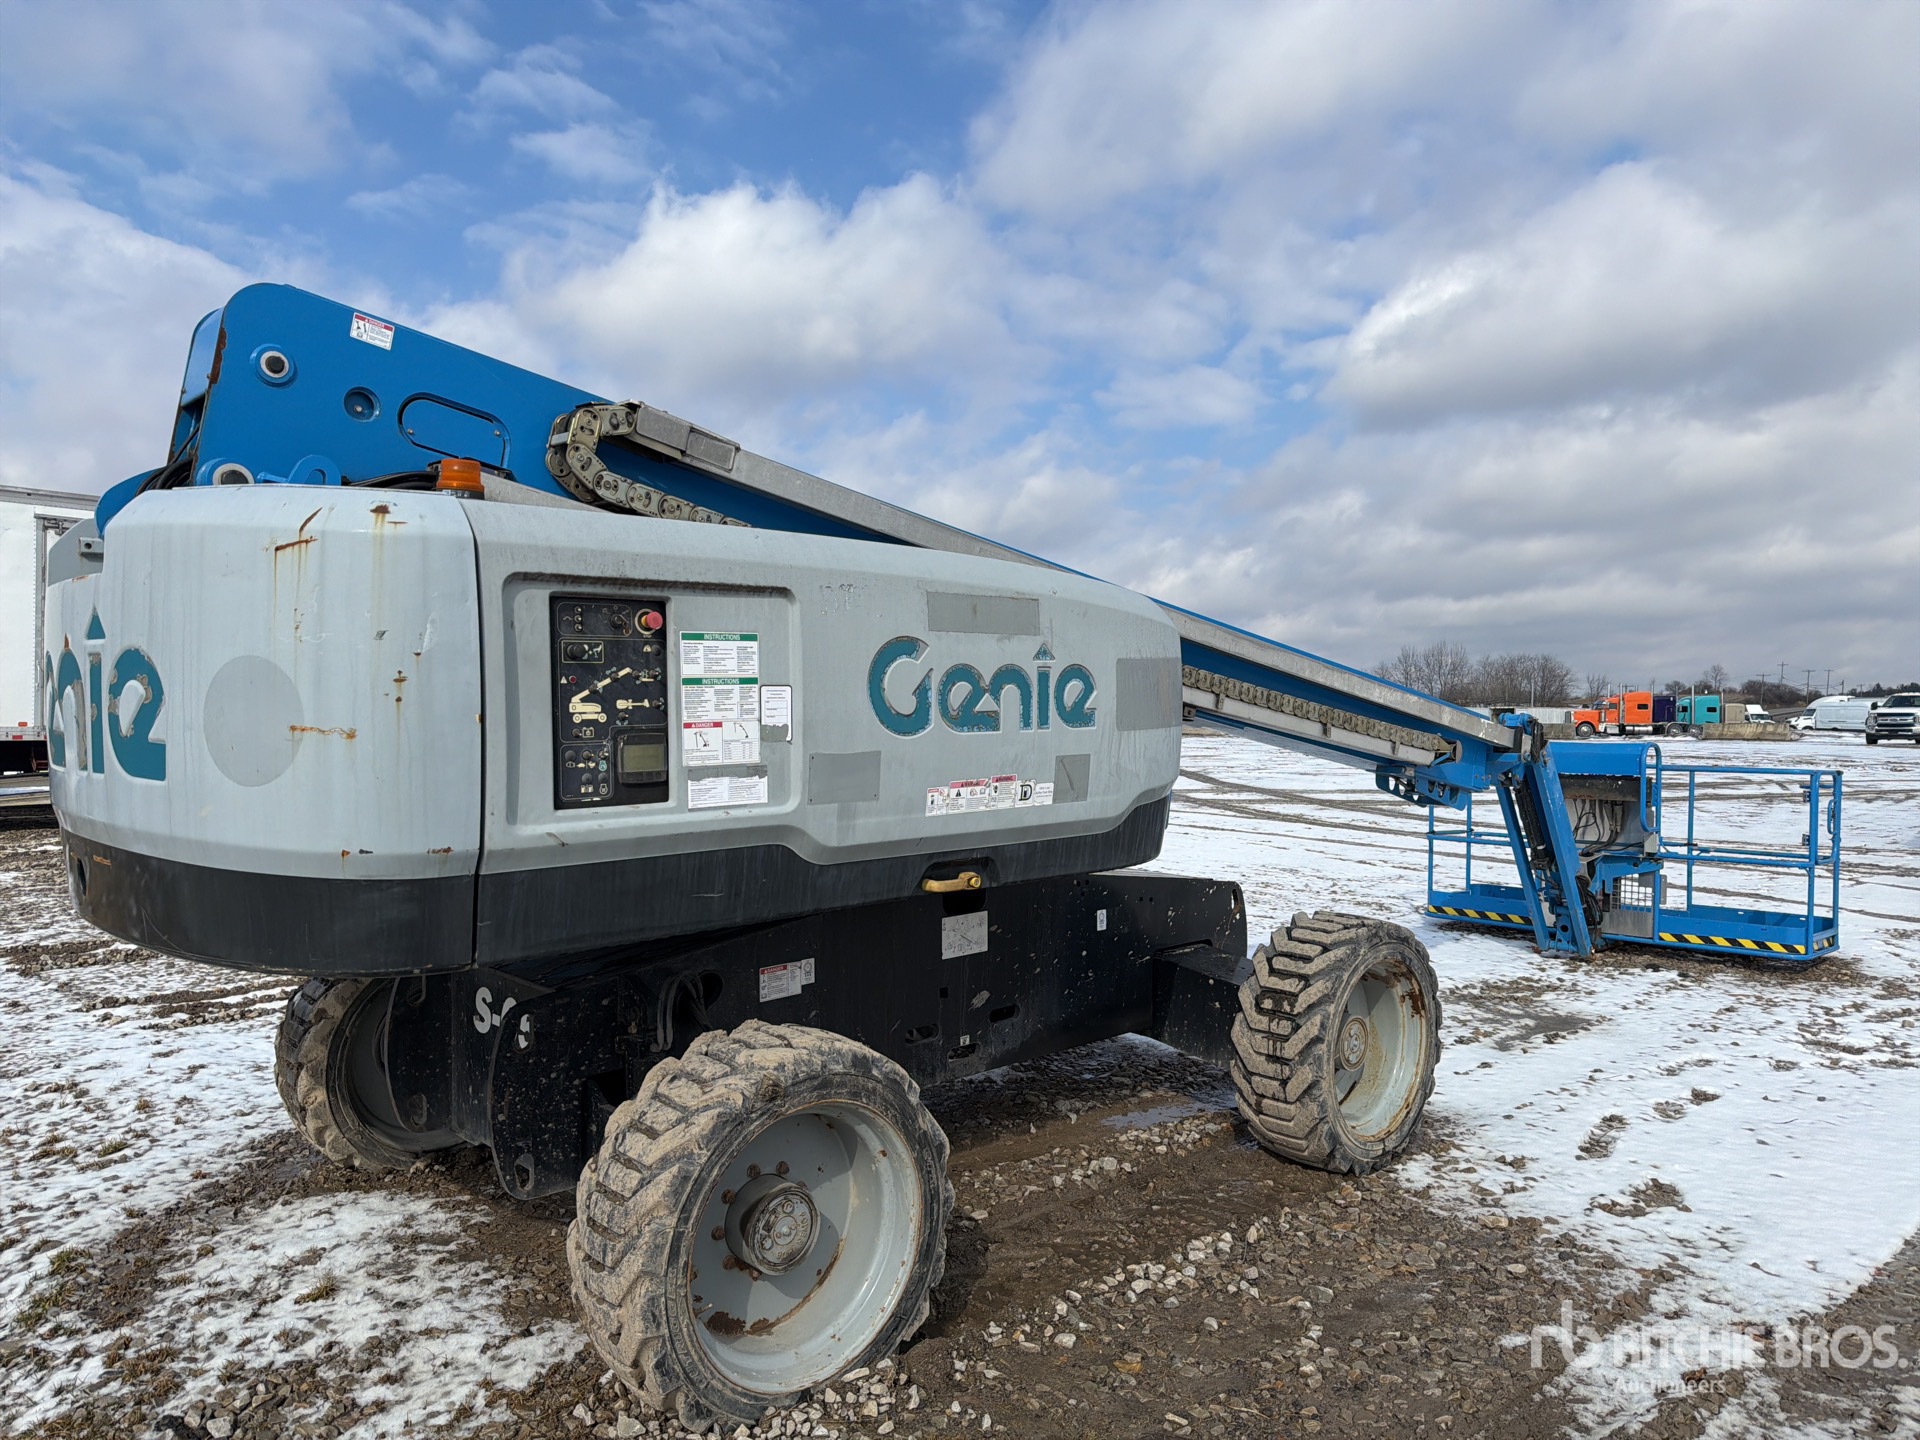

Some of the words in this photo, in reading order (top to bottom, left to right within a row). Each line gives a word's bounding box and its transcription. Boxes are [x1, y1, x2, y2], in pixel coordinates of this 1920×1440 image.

[703, 633, 741, 641] INSTRUCTIONS
[866, 635, 1098, 738] Genie
[695, 721, 714, 729] DANGER
